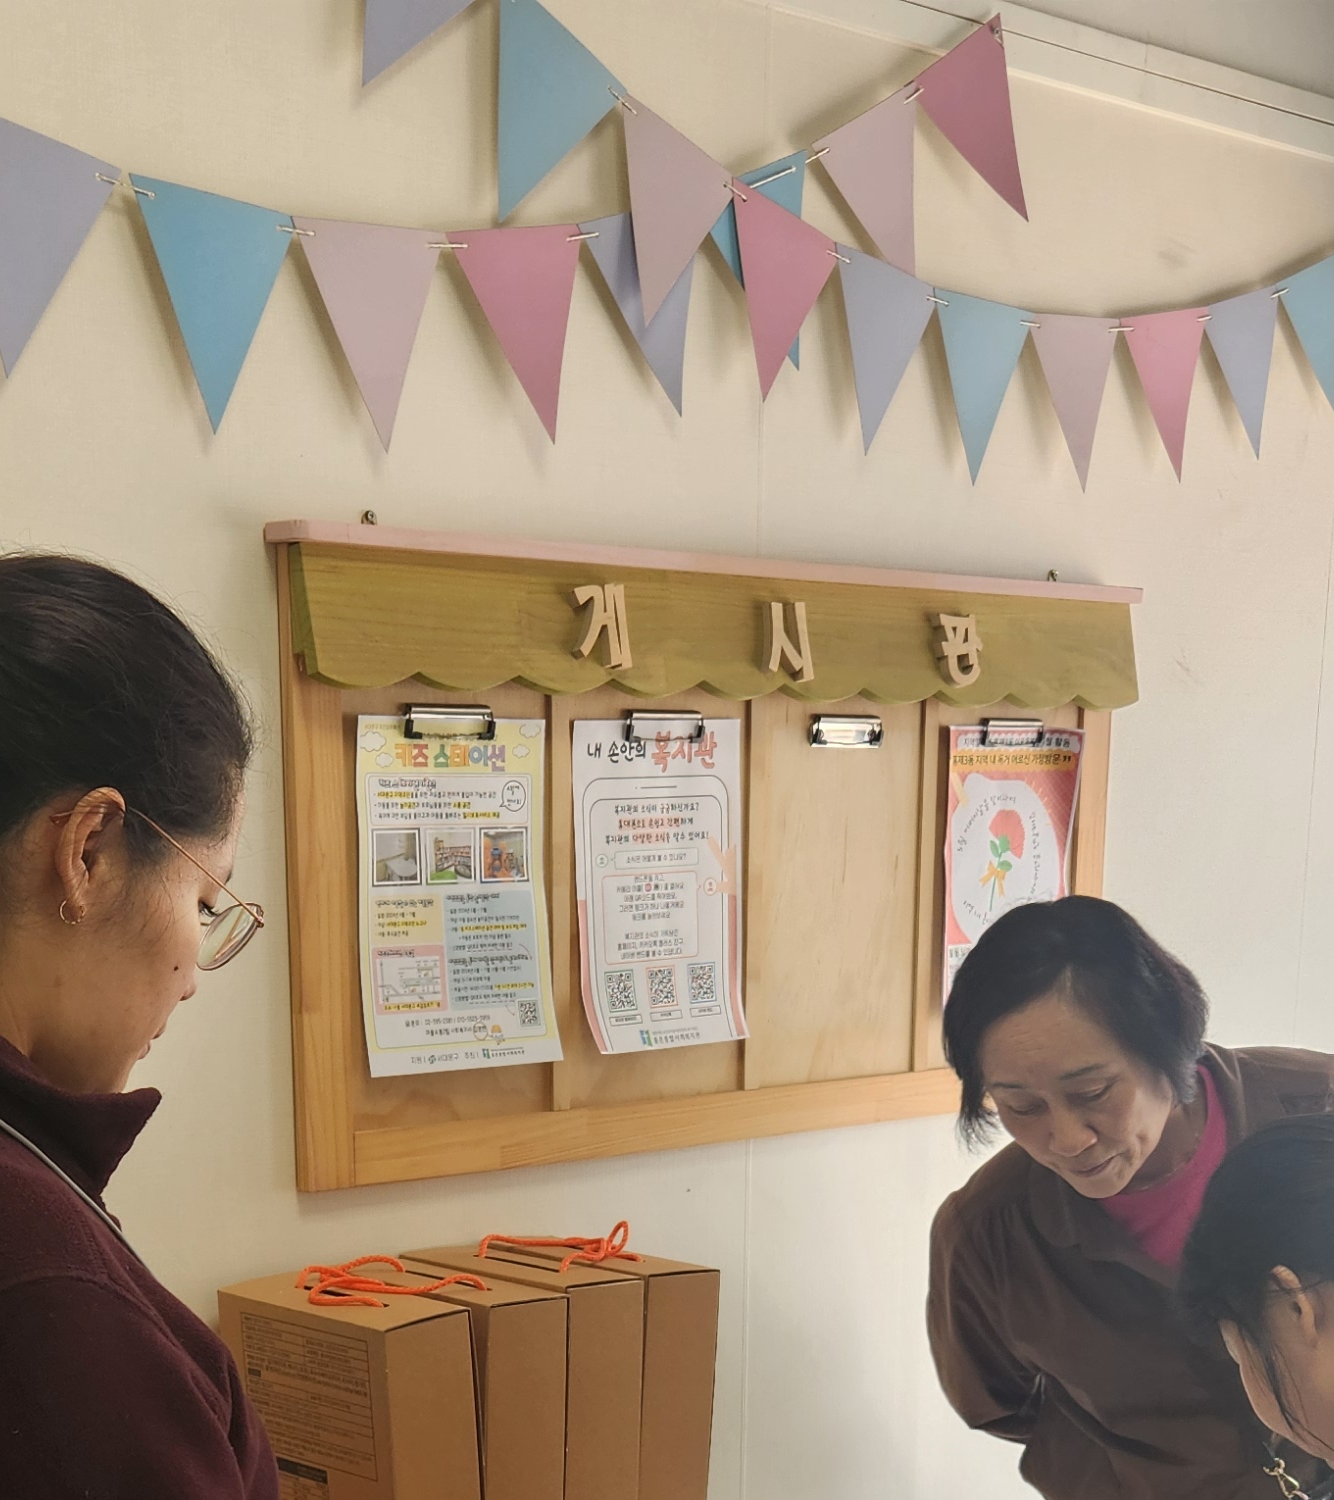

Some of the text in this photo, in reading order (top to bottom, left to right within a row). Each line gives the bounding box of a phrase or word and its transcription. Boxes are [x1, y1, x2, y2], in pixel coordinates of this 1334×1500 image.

[395, 743, 506, 772] 키즈 스테이션
[587, 731, 717, 773] 내 손안의 복지관
